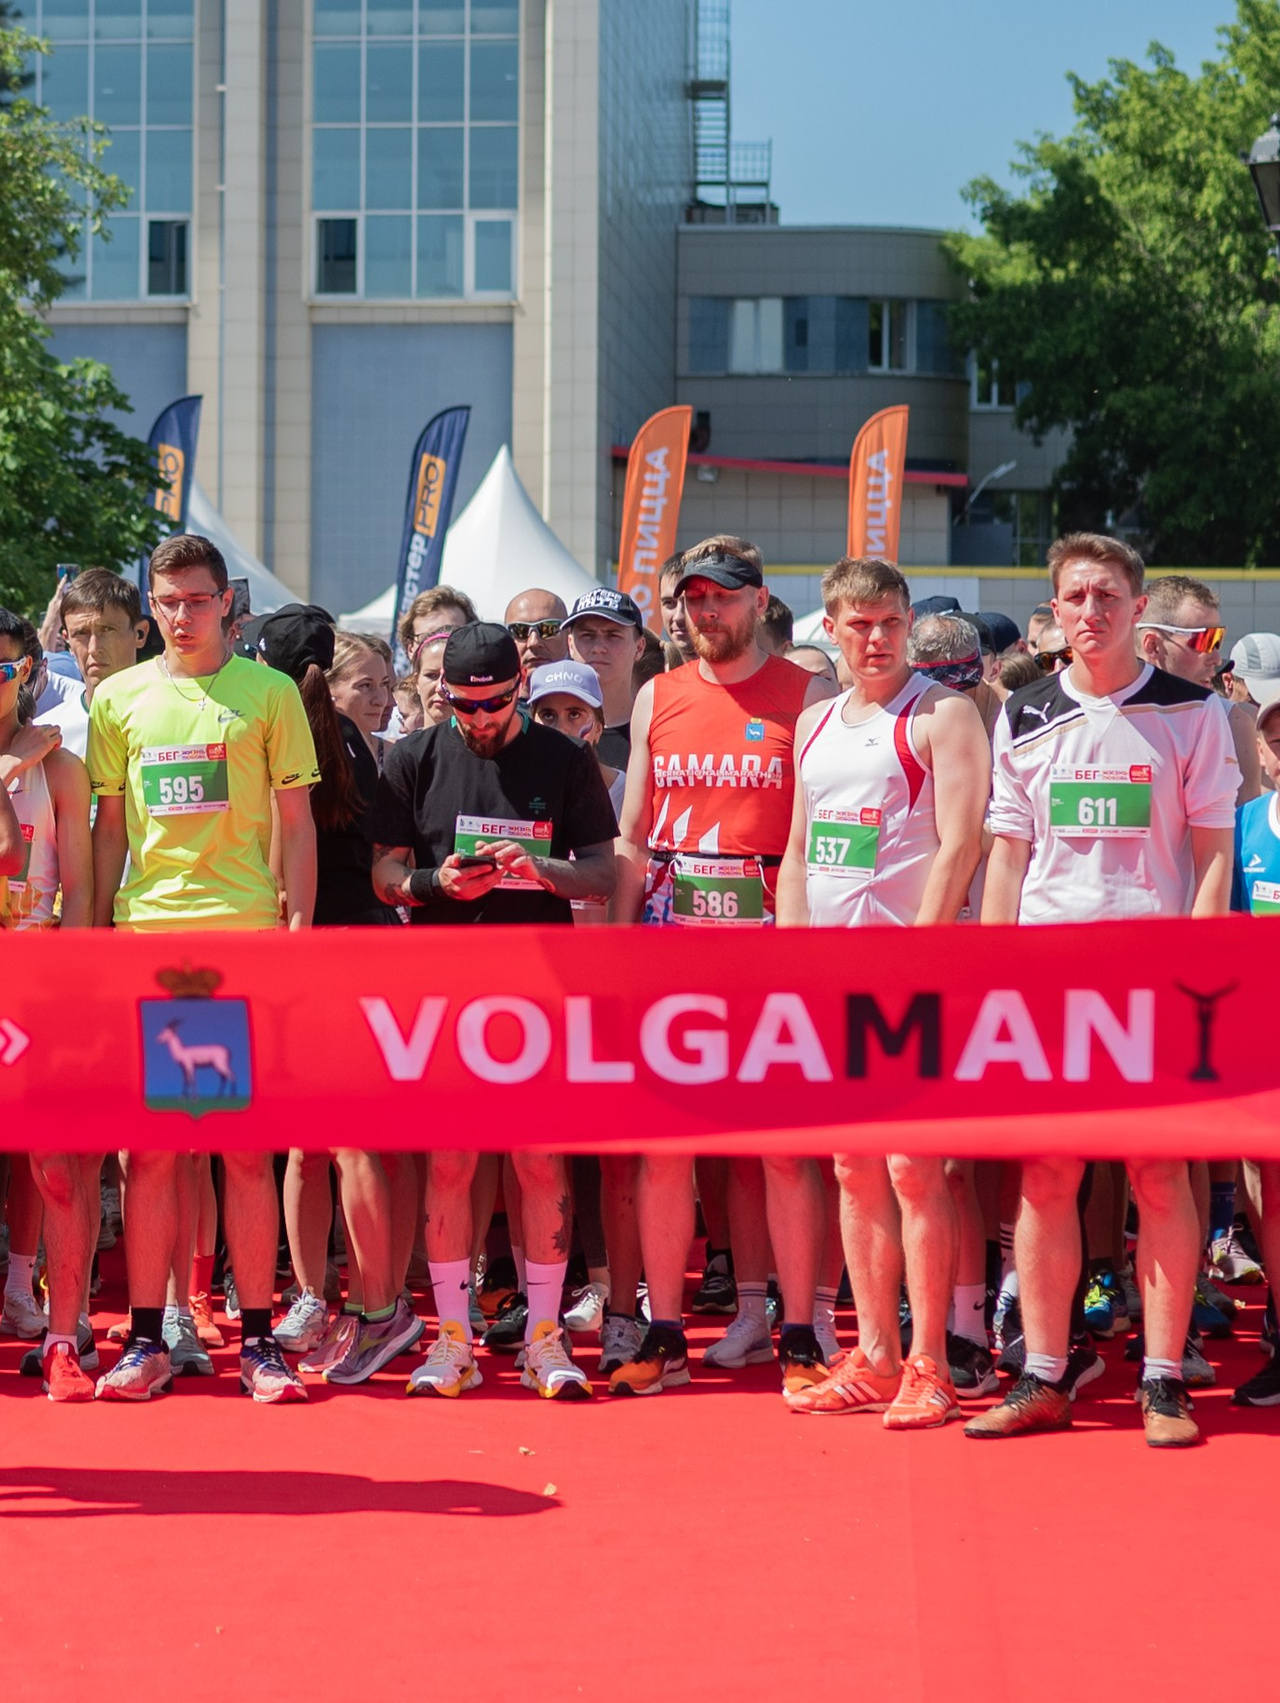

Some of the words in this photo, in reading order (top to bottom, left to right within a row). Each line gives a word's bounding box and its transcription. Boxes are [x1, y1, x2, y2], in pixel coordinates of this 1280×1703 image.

[417, 459, 441, 530] PRO
[633, 446, 671, 575] ПИЦЦА
[158, 751, 179, 761] БЕГ
[1075, 770, 1100, 780] БЕГ
[159, 775, 204, 804] 595
[1078, 797, 1117, 825] 611
[481, 824, 506, 834] БЕГ
[815, 836, 851, 864] 537
[693, 865, 717, 875] БЕГ
[692, 890, 738, 918] 586
[359, 988, 1156, 1085] VOLGAMAN
